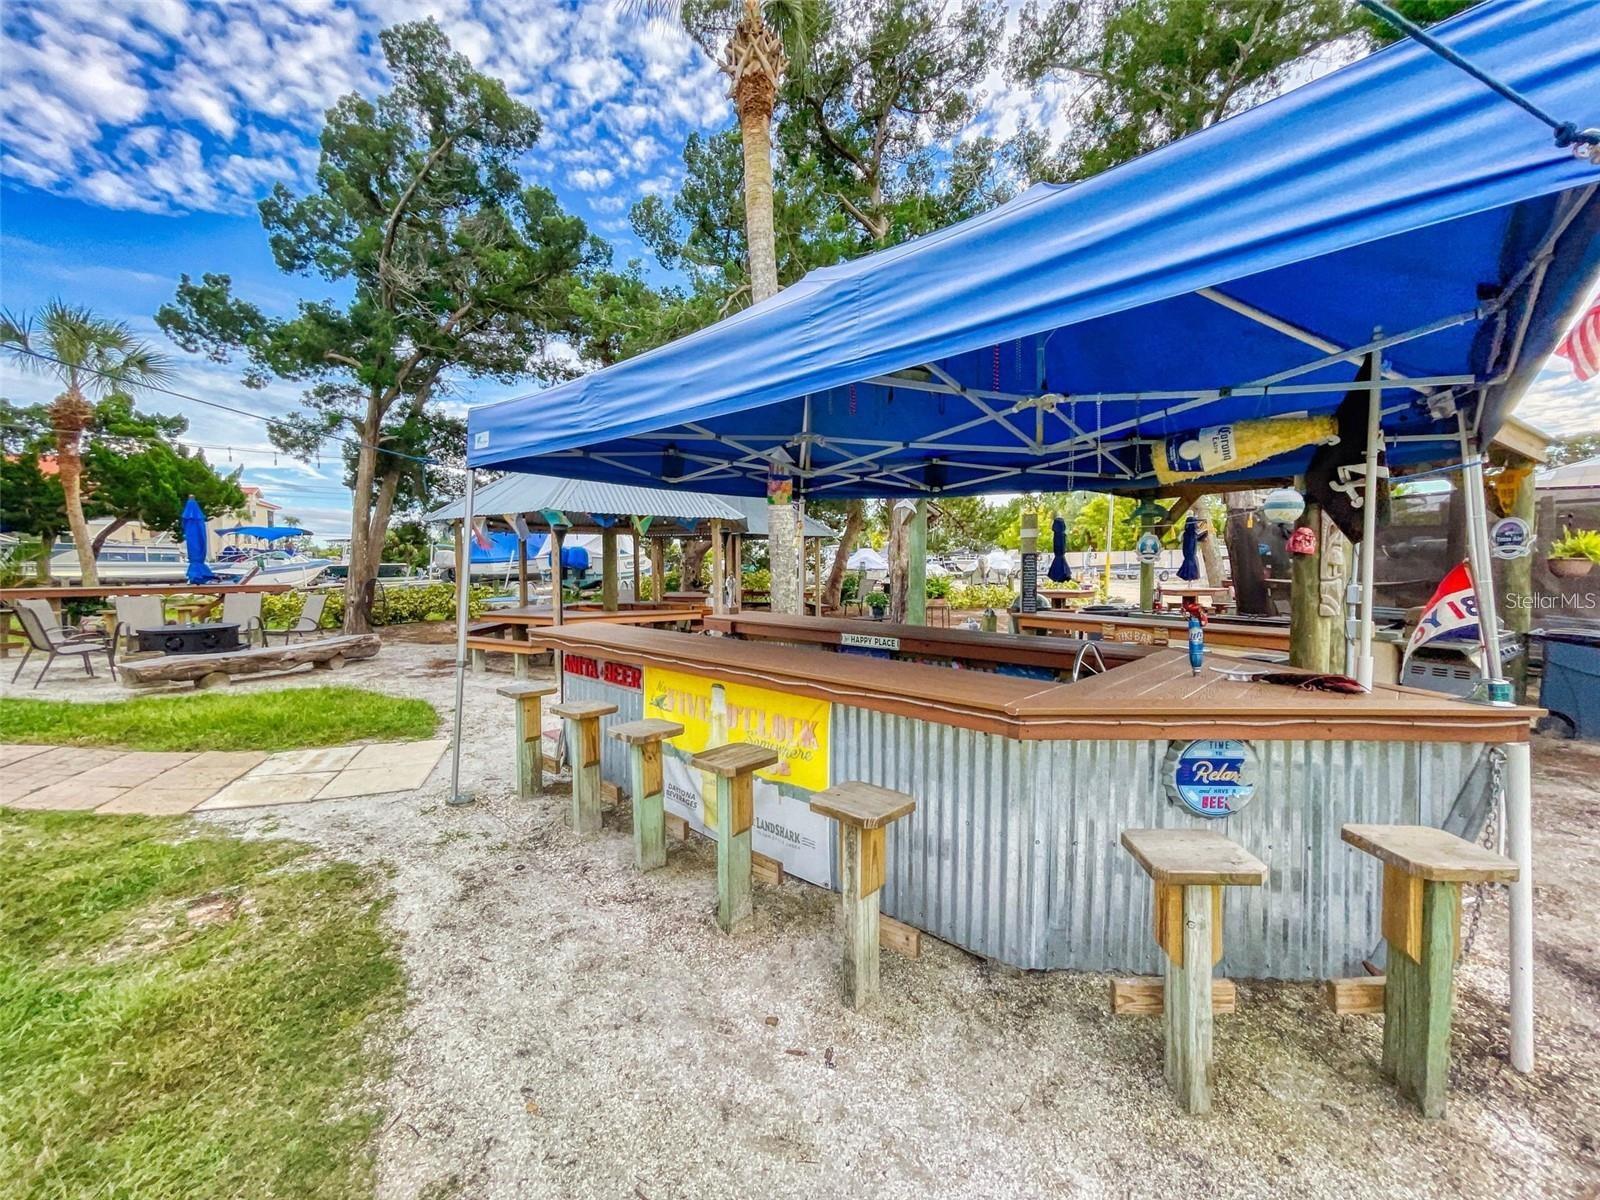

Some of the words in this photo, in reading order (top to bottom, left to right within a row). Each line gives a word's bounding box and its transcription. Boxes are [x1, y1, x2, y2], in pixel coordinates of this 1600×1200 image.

[1218, 426, 1232, 461] Corona
[850, 635, 873, 645] HAPPY
[874, 637, 896, 648] PLACE
[604, 661, 642, 690] BEER
[1209, 741, 1230, 749] TIME
[665, 789, 699, 810] BEVERAGES
[667, 782, 697, 801] DAYTONA
[756, 816, 802, 845] LANDSHARK
